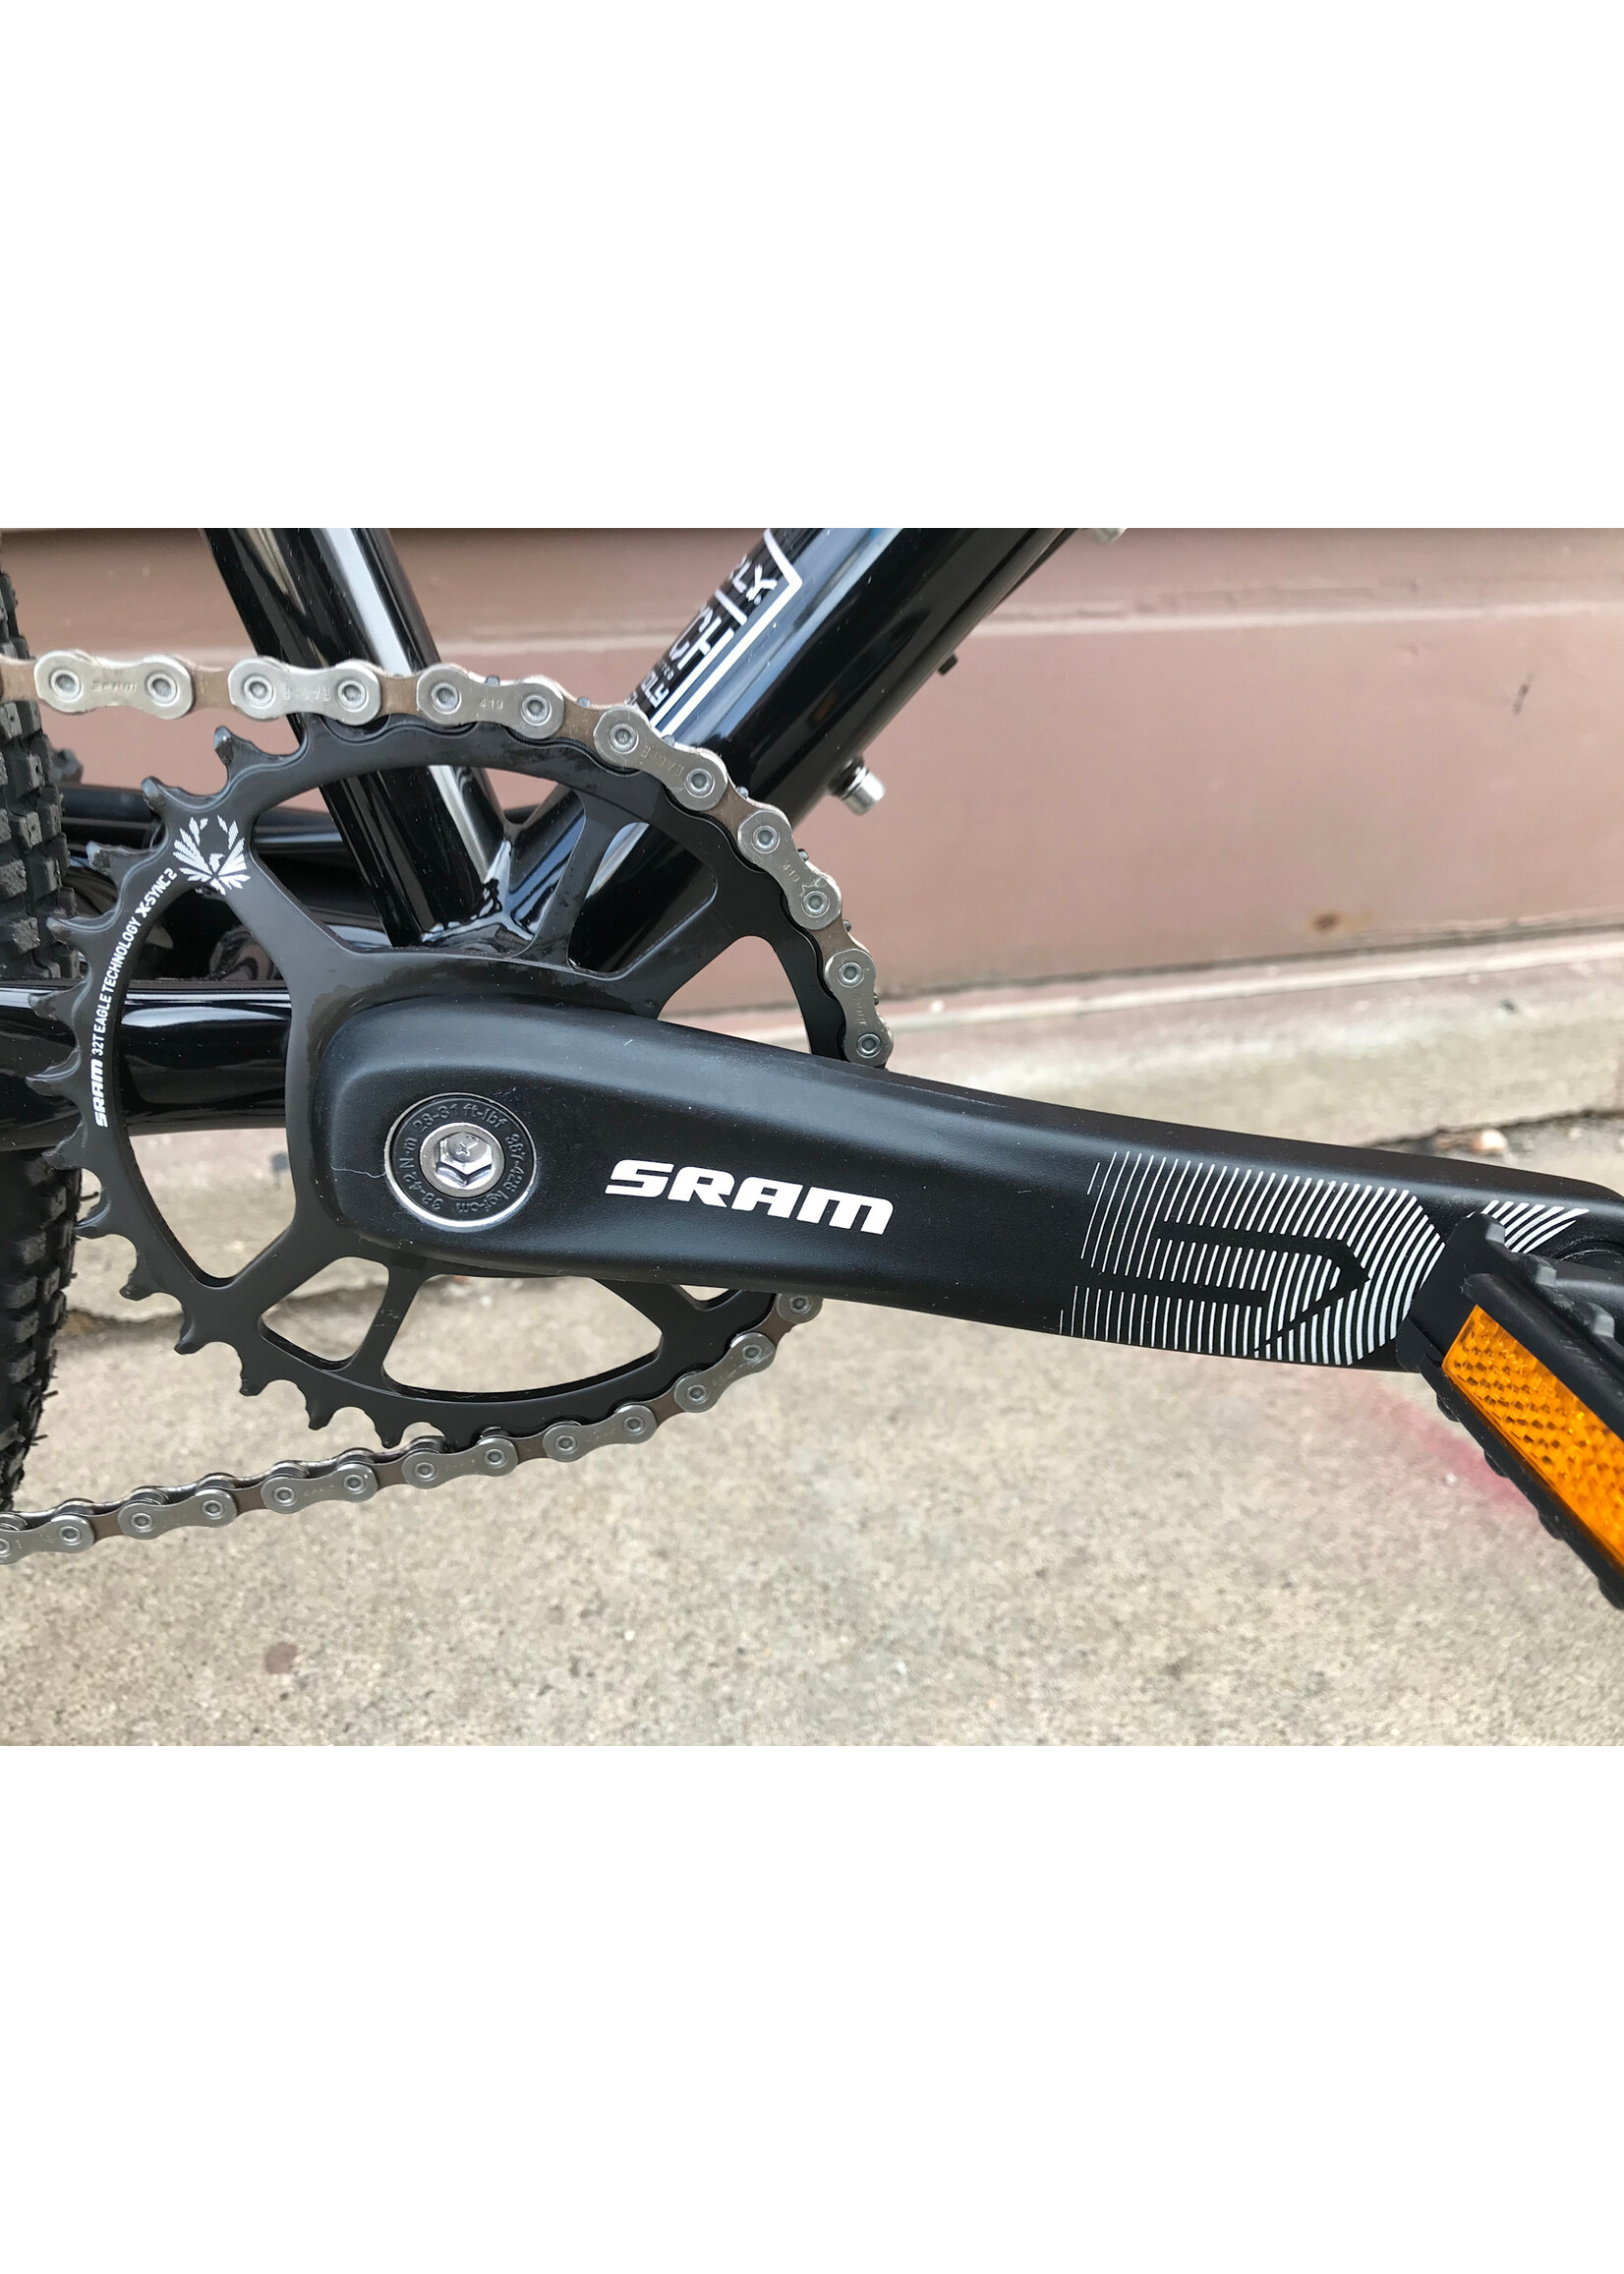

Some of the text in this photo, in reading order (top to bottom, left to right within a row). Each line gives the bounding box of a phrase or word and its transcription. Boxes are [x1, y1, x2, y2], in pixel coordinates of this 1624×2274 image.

[134, 874, 172, 918] X-SYNC
[101, 916, 142, 993] TECHNOLOGY
[93, 993, 113, 1034] EAGLE
[91, 1033, 105, 1057] 32T
[90, 1058, 109, 1128] SRAM
[605, 1158, 894, 1236] SRAM
